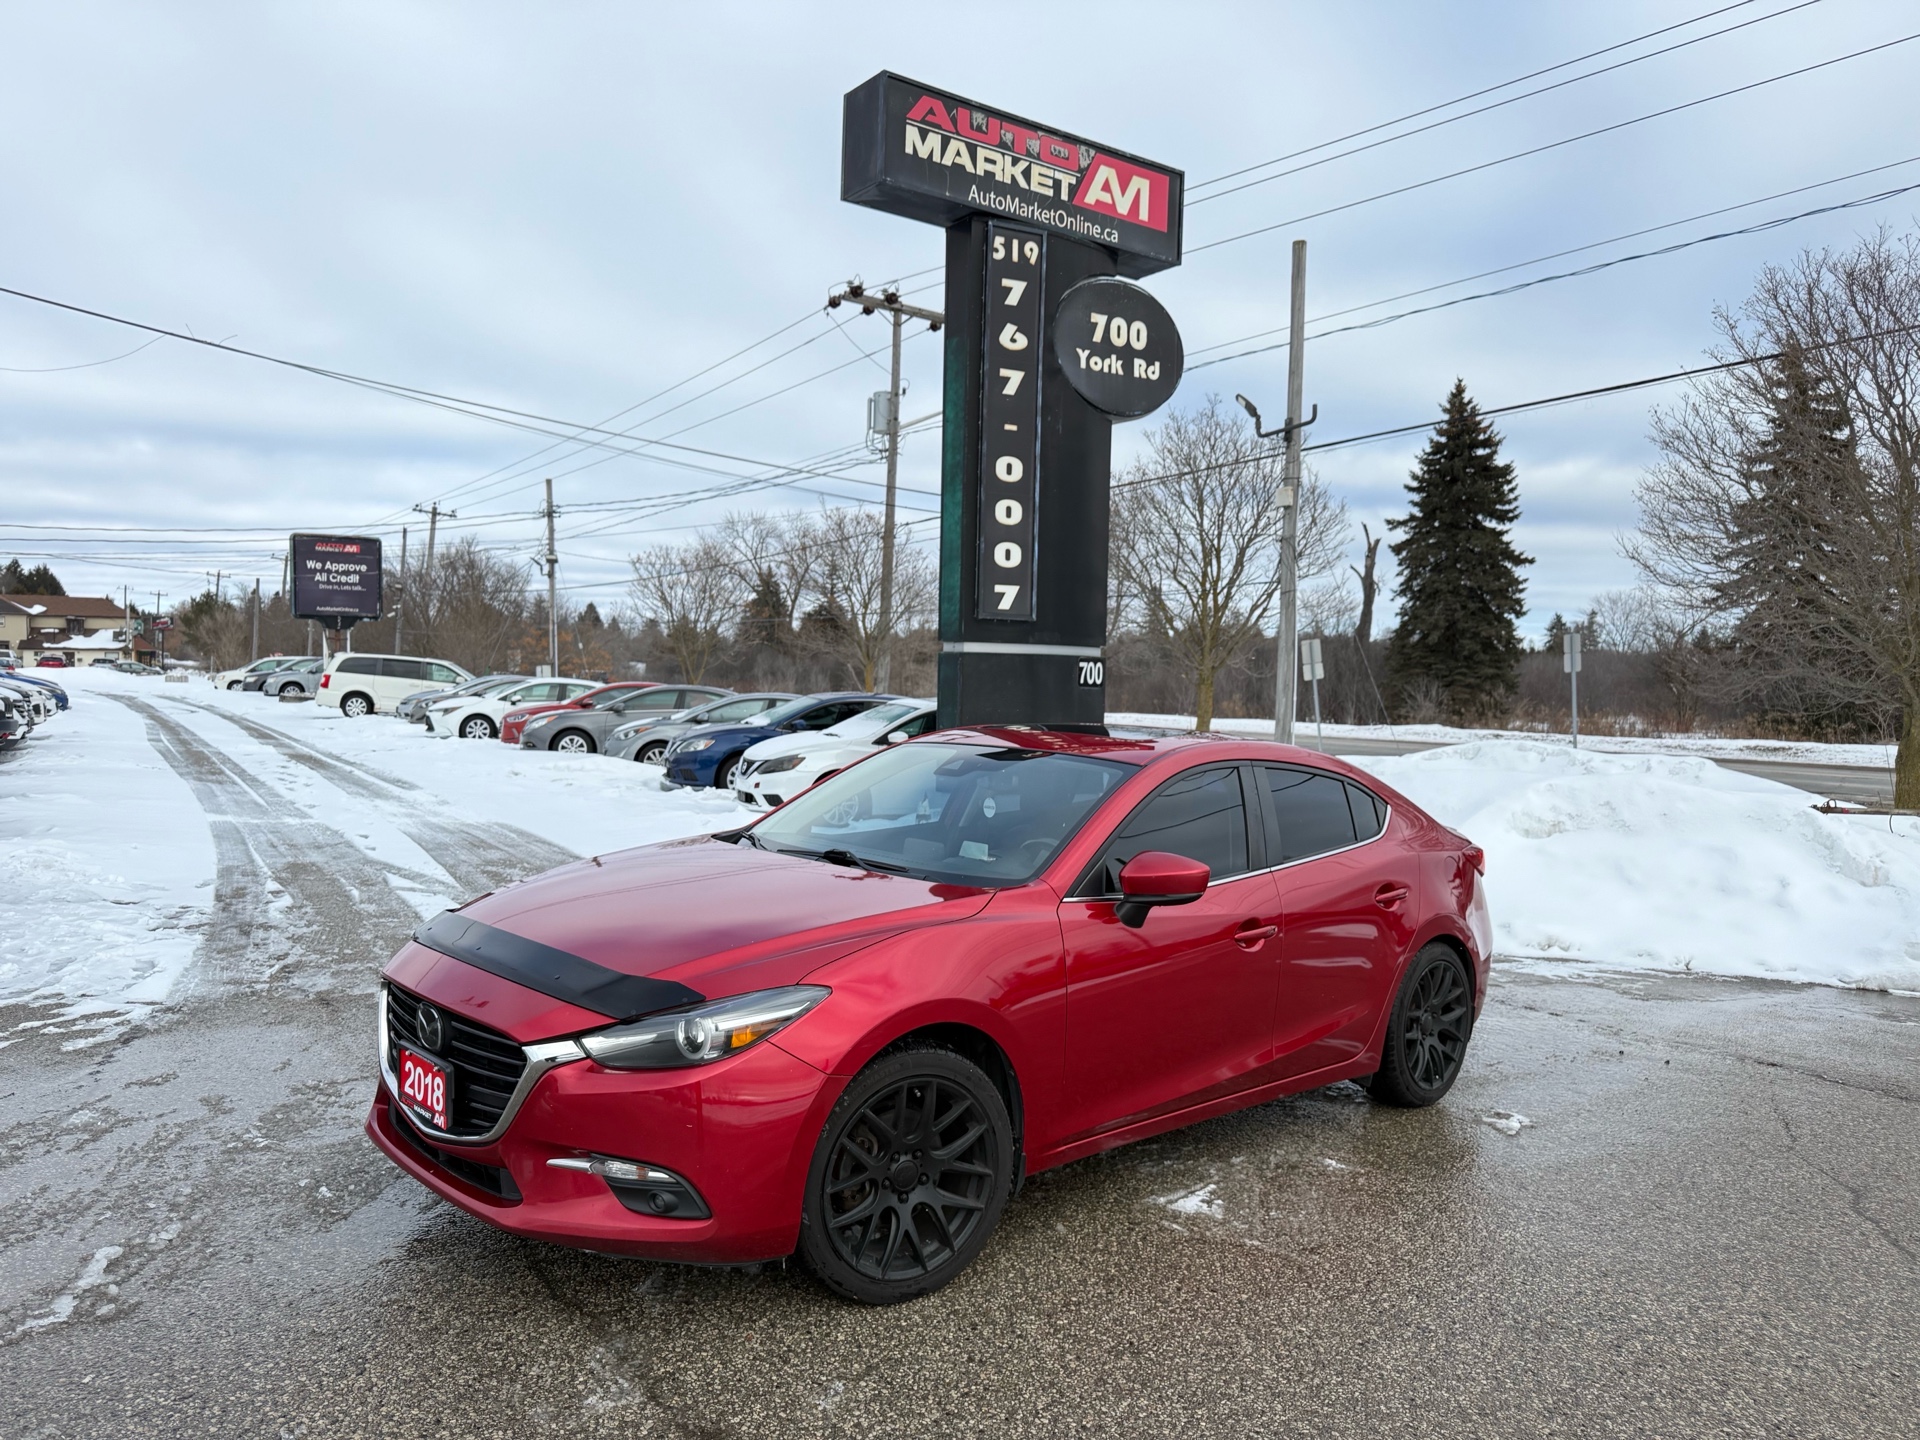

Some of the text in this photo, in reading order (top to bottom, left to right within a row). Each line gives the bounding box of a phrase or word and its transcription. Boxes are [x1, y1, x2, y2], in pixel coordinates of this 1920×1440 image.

[906, 95, 1078, 171] AUTO
[905, 124, 1077, 201] MARKET
[1084, 164, 1150, 222] AM
[968, 185, 1119, 243] AutoMarketOnline.ca
[992, 235, 1040, 266] 519
[1090, 312, 1148, 351] 700
[1076, 347, 1160, 381] York Rd
[306, 560, 367, 572] We Approve
[314, 572, 359, 583] All Credit
[1078, 661, 1103, 685] 700
[404, 1060, 444, 1112] 2018
